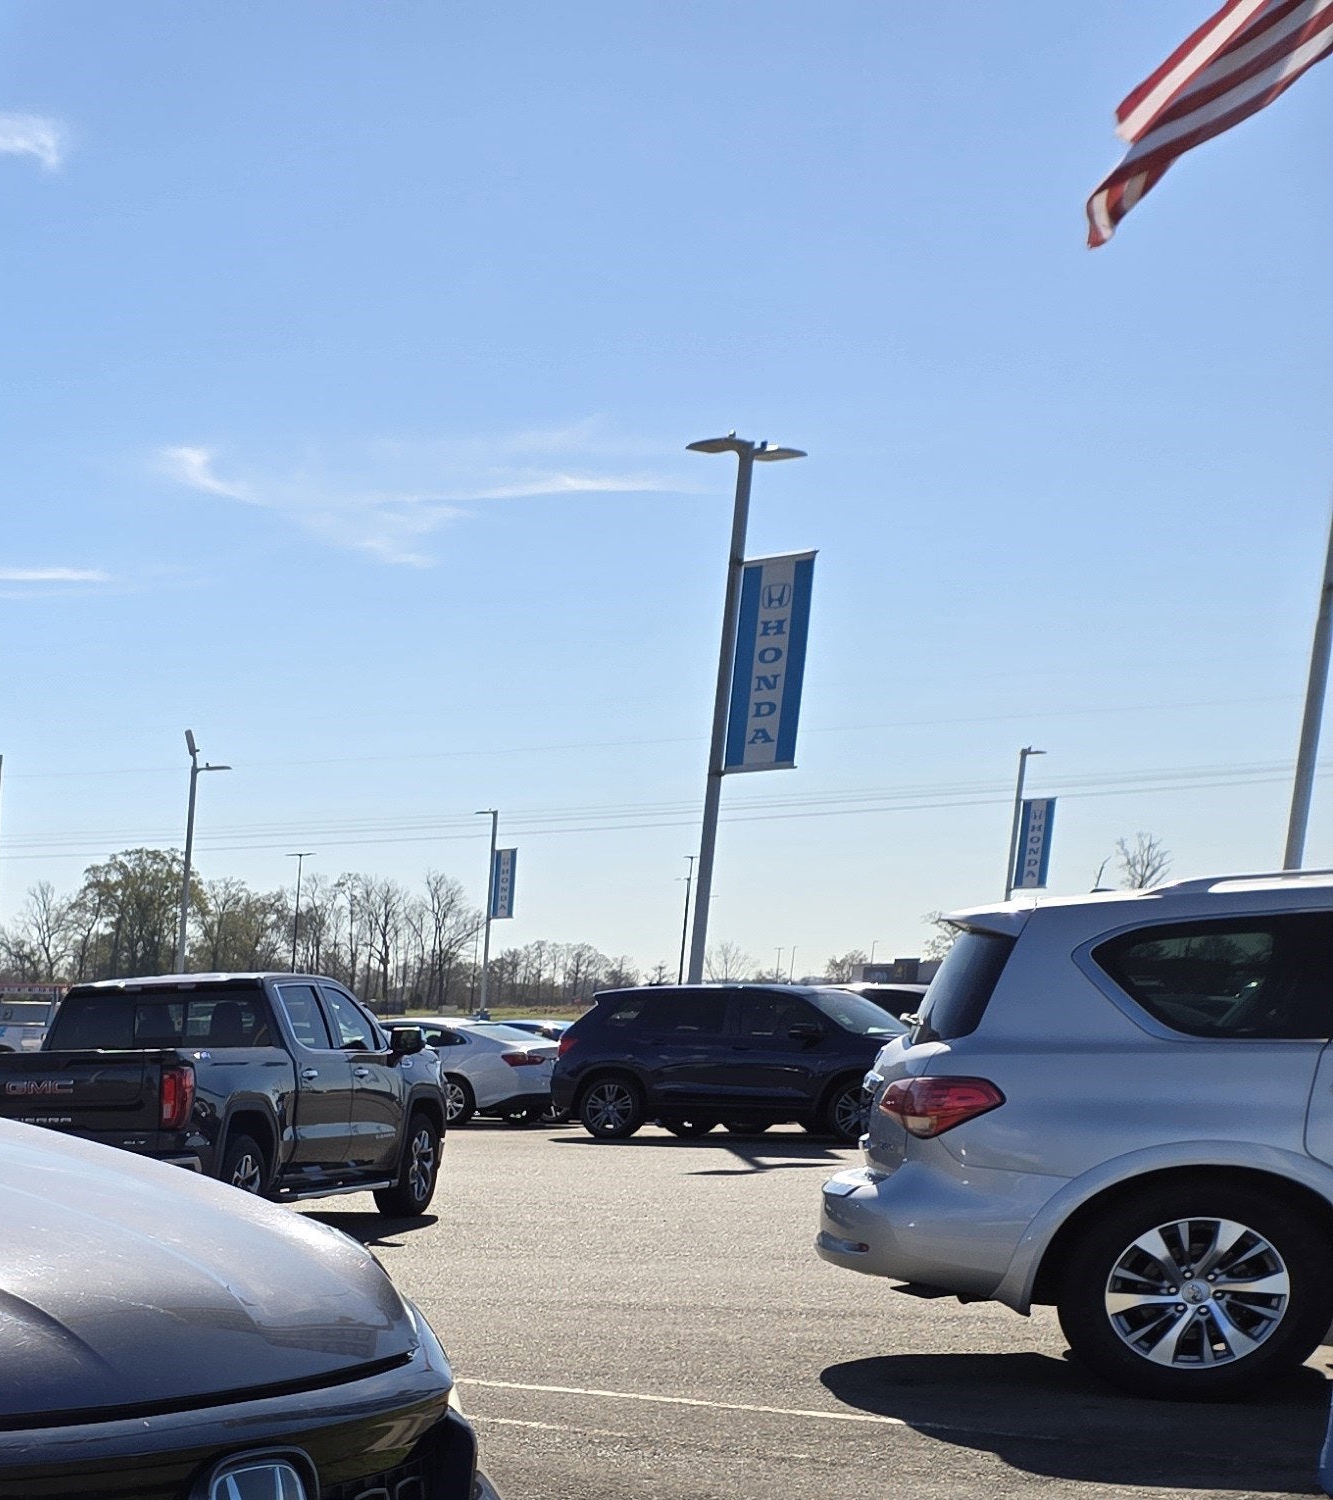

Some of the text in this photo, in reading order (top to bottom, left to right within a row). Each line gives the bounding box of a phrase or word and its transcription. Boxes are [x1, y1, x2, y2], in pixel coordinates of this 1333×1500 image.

[747, 618, 787, 745] HONDA
[1025, 824, 1043, 878] HONDA
[5, 1080, 74, 1095] GMC
